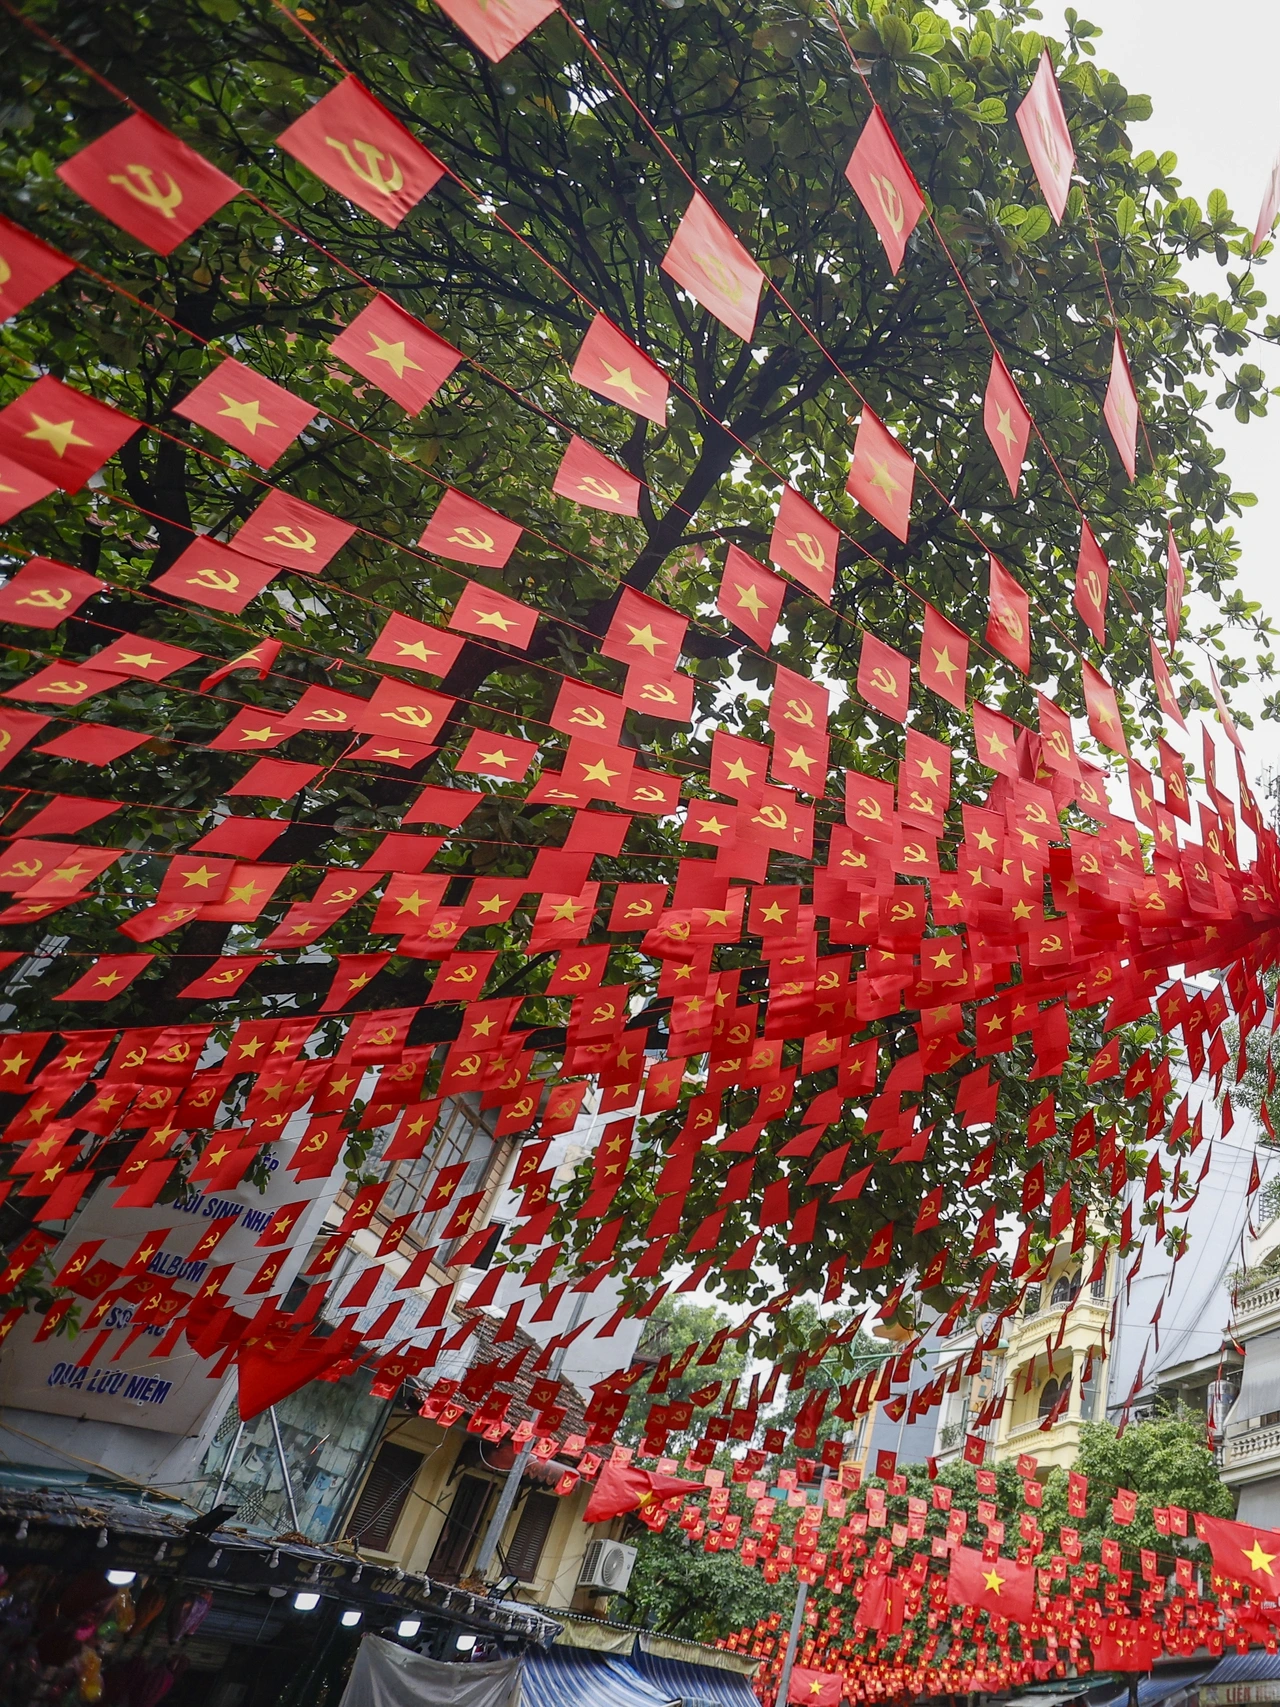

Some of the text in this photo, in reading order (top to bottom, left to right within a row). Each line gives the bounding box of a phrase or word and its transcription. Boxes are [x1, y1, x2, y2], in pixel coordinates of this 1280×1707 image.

[202, 1197, 244, 1220] SINH
[241, 1208, 275, 1237] NHẬ
[146, 1251, 209, 1282] ALBUM
[123, 1373, 173, 1405] NIỆM
